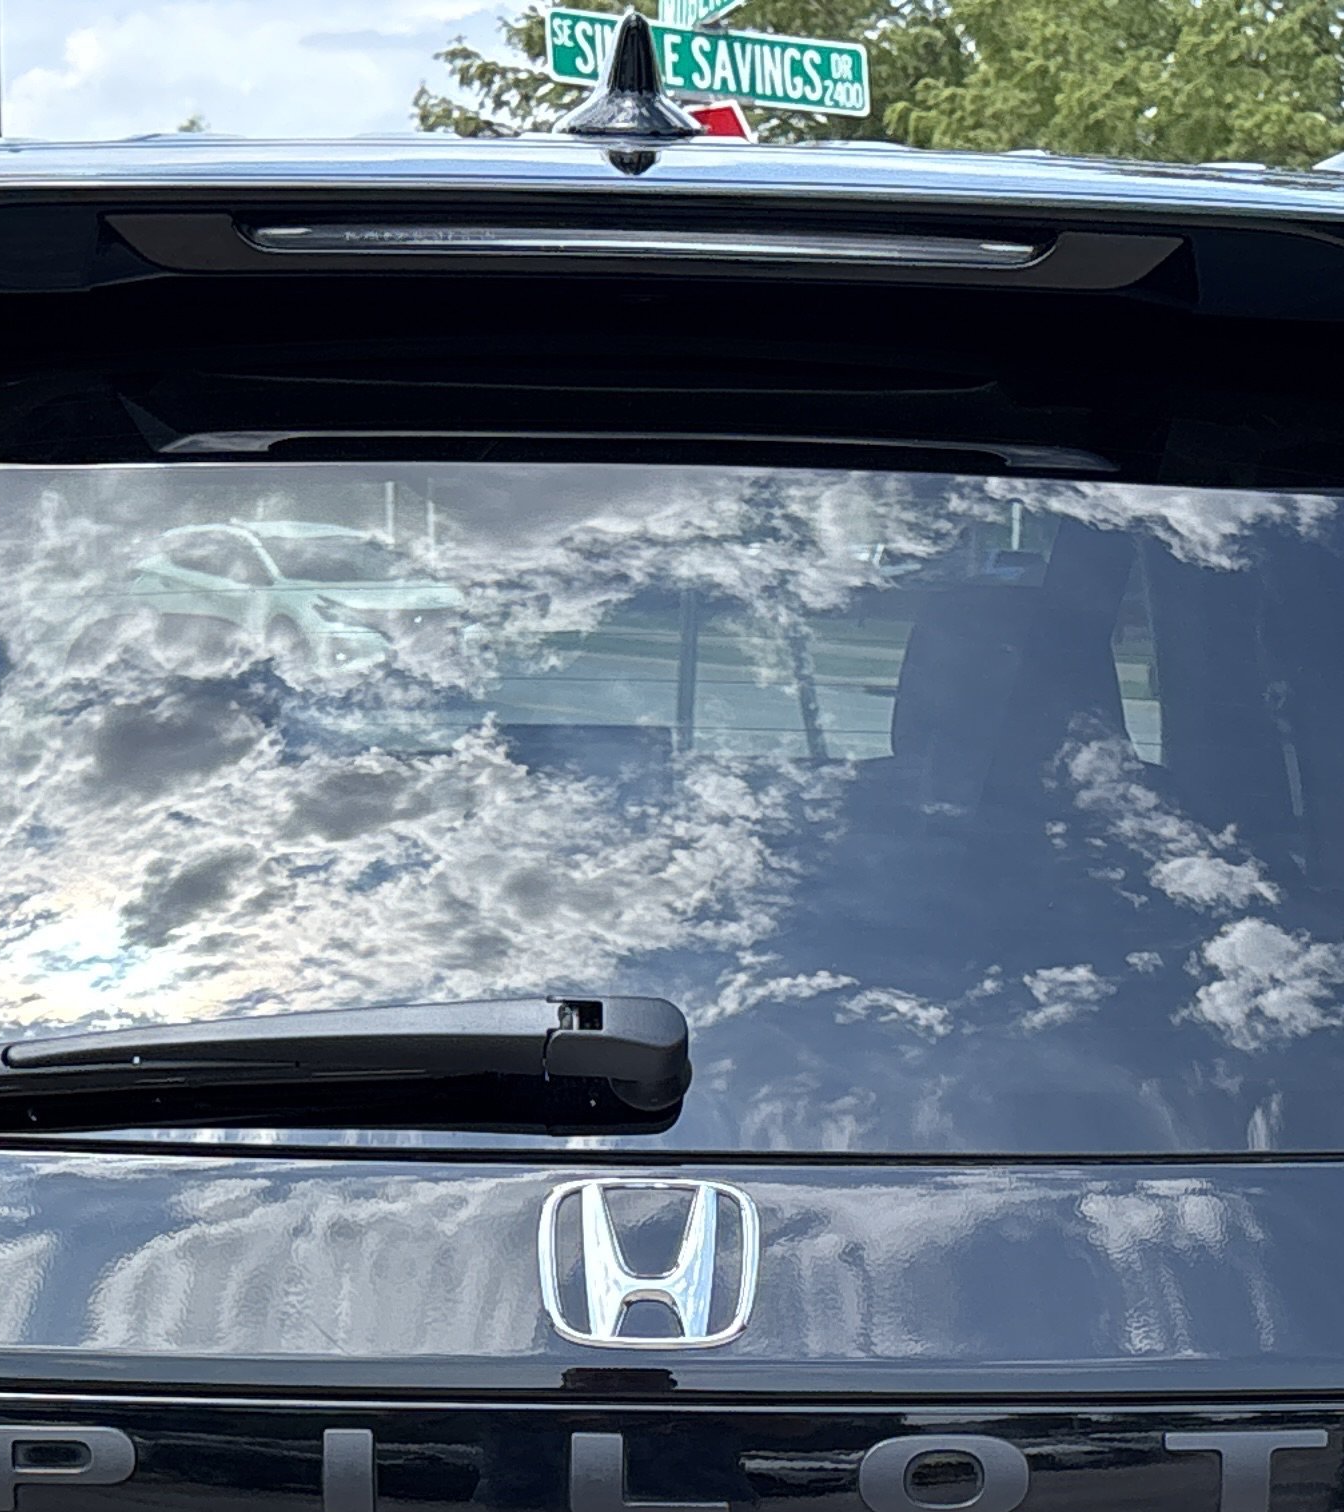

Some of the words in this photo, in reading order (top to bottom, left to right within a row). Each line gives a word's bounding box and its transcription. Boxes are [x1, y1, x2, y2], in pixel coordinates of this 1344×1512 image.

[552, 17, 575, 47] SE
[575, 20, 685, 87] SIE
[691, 36, 823, 101] SAVINGS
[830, 52, 853, 81] DR
[824, 79, 863, 108] 2400
